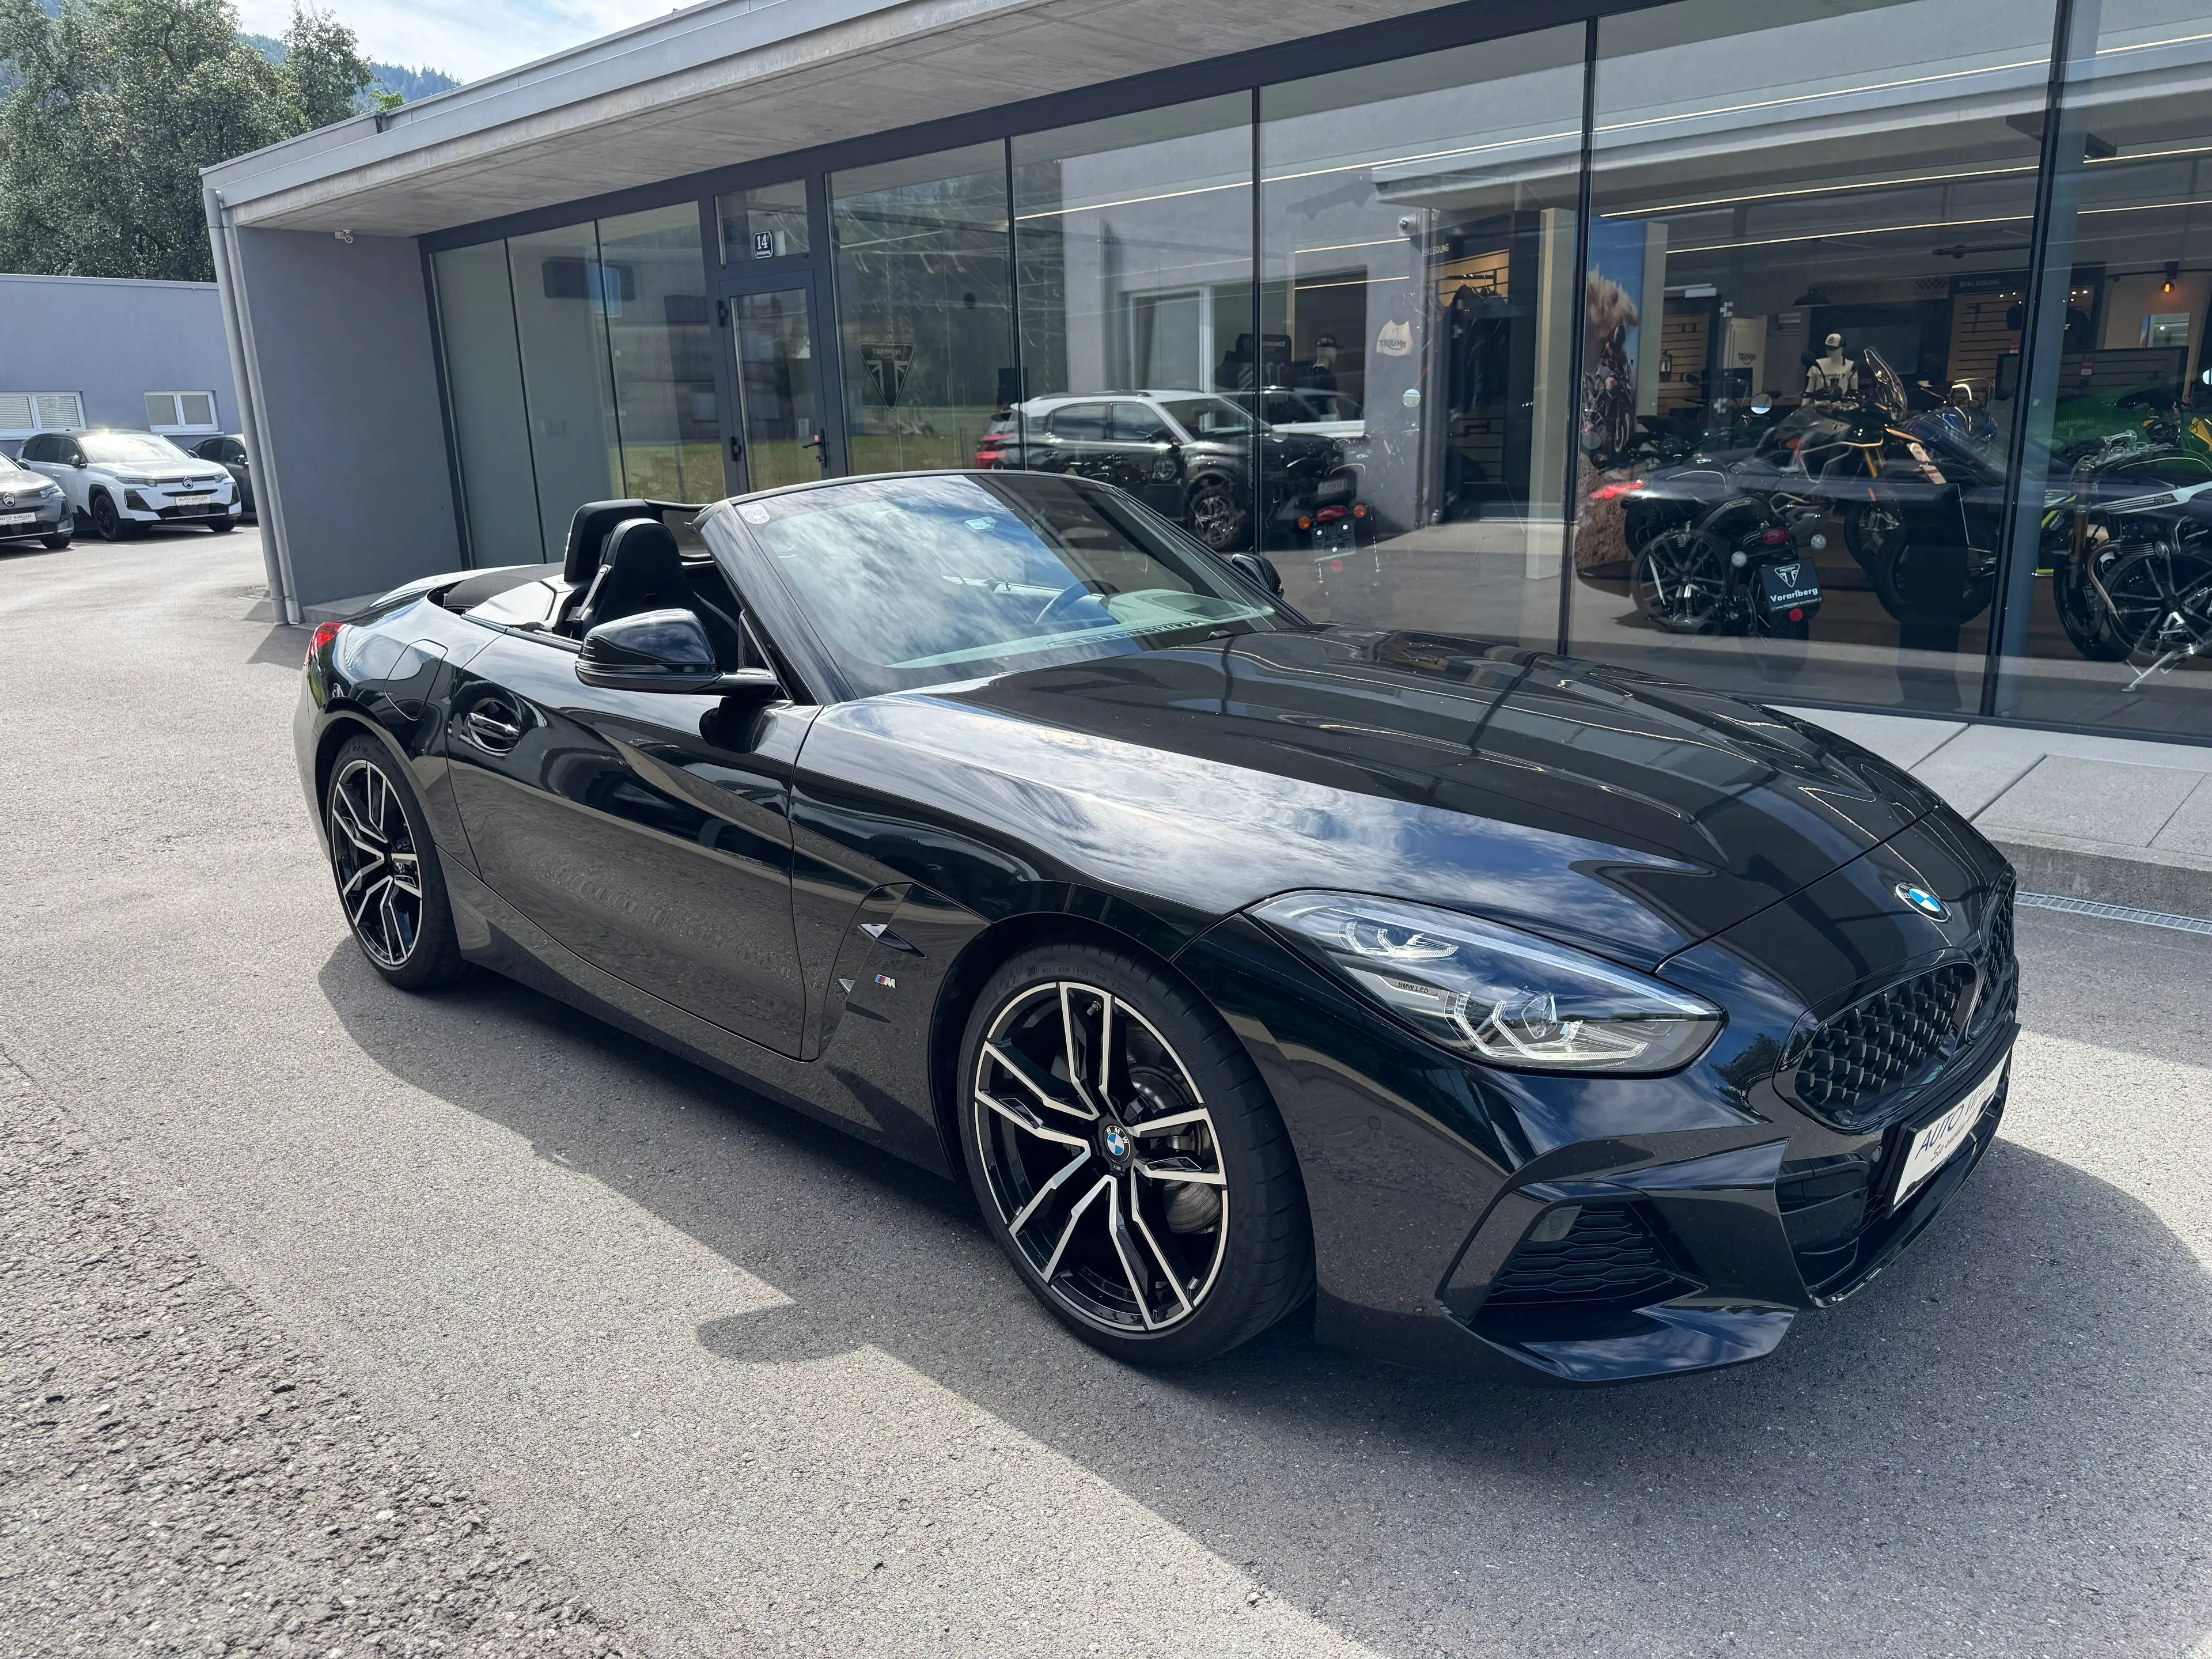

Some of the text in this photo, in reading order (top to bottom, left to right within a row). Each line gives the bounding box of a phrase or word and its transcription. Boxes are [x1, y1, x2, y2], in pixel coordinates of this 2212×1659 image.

[756, 234, 768, 249] 14
[2155, 495, 2172, 505] RS
[1770, 588, 1819, 603] Vorarlberg
[1398, 982, 1415, 990] BMW
[1106, 1127, 1129, 1144] BMW
[1914, 1103, 1965, 1160] AUTO
